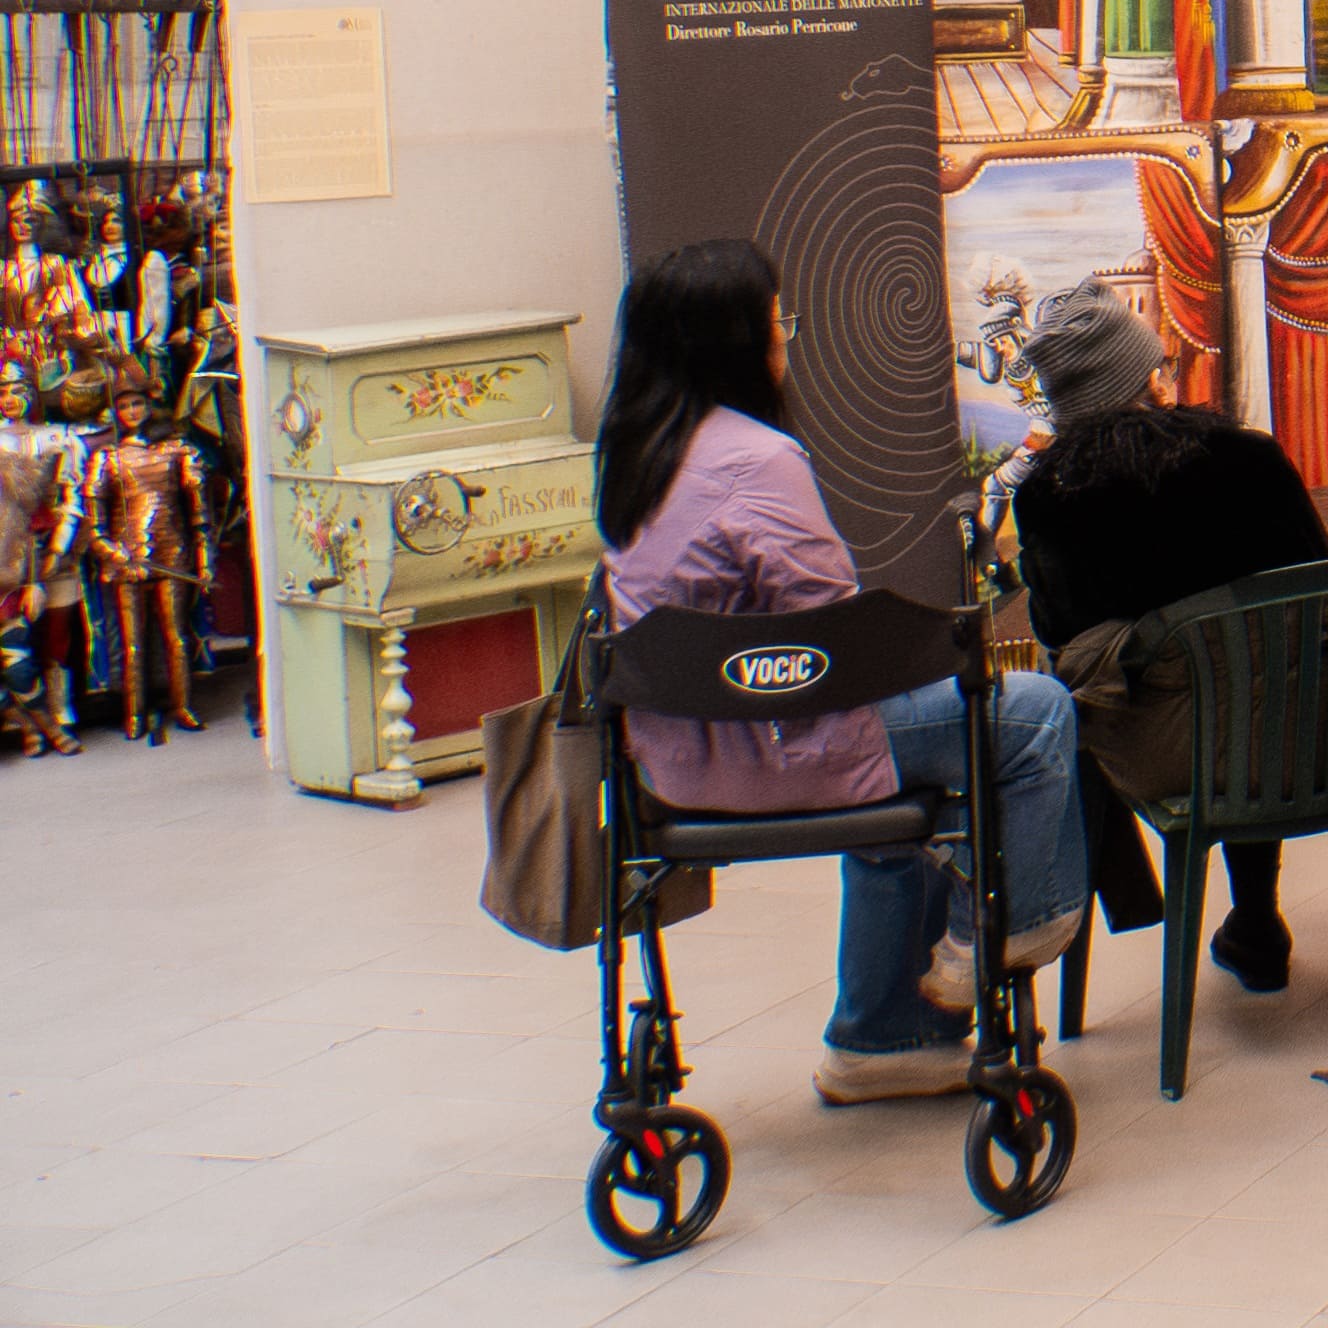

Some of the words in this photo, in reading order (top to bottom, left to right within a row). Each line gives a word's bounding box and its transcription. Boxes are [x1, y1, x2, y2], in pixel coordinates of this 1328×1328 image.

[665, 0, 789, 17] INTERNAZIONALE
[666, 22, 731, 42] Direttore
[735, 19, 789, 38] Rosario
[792, 16, 859, 34] Perricone
